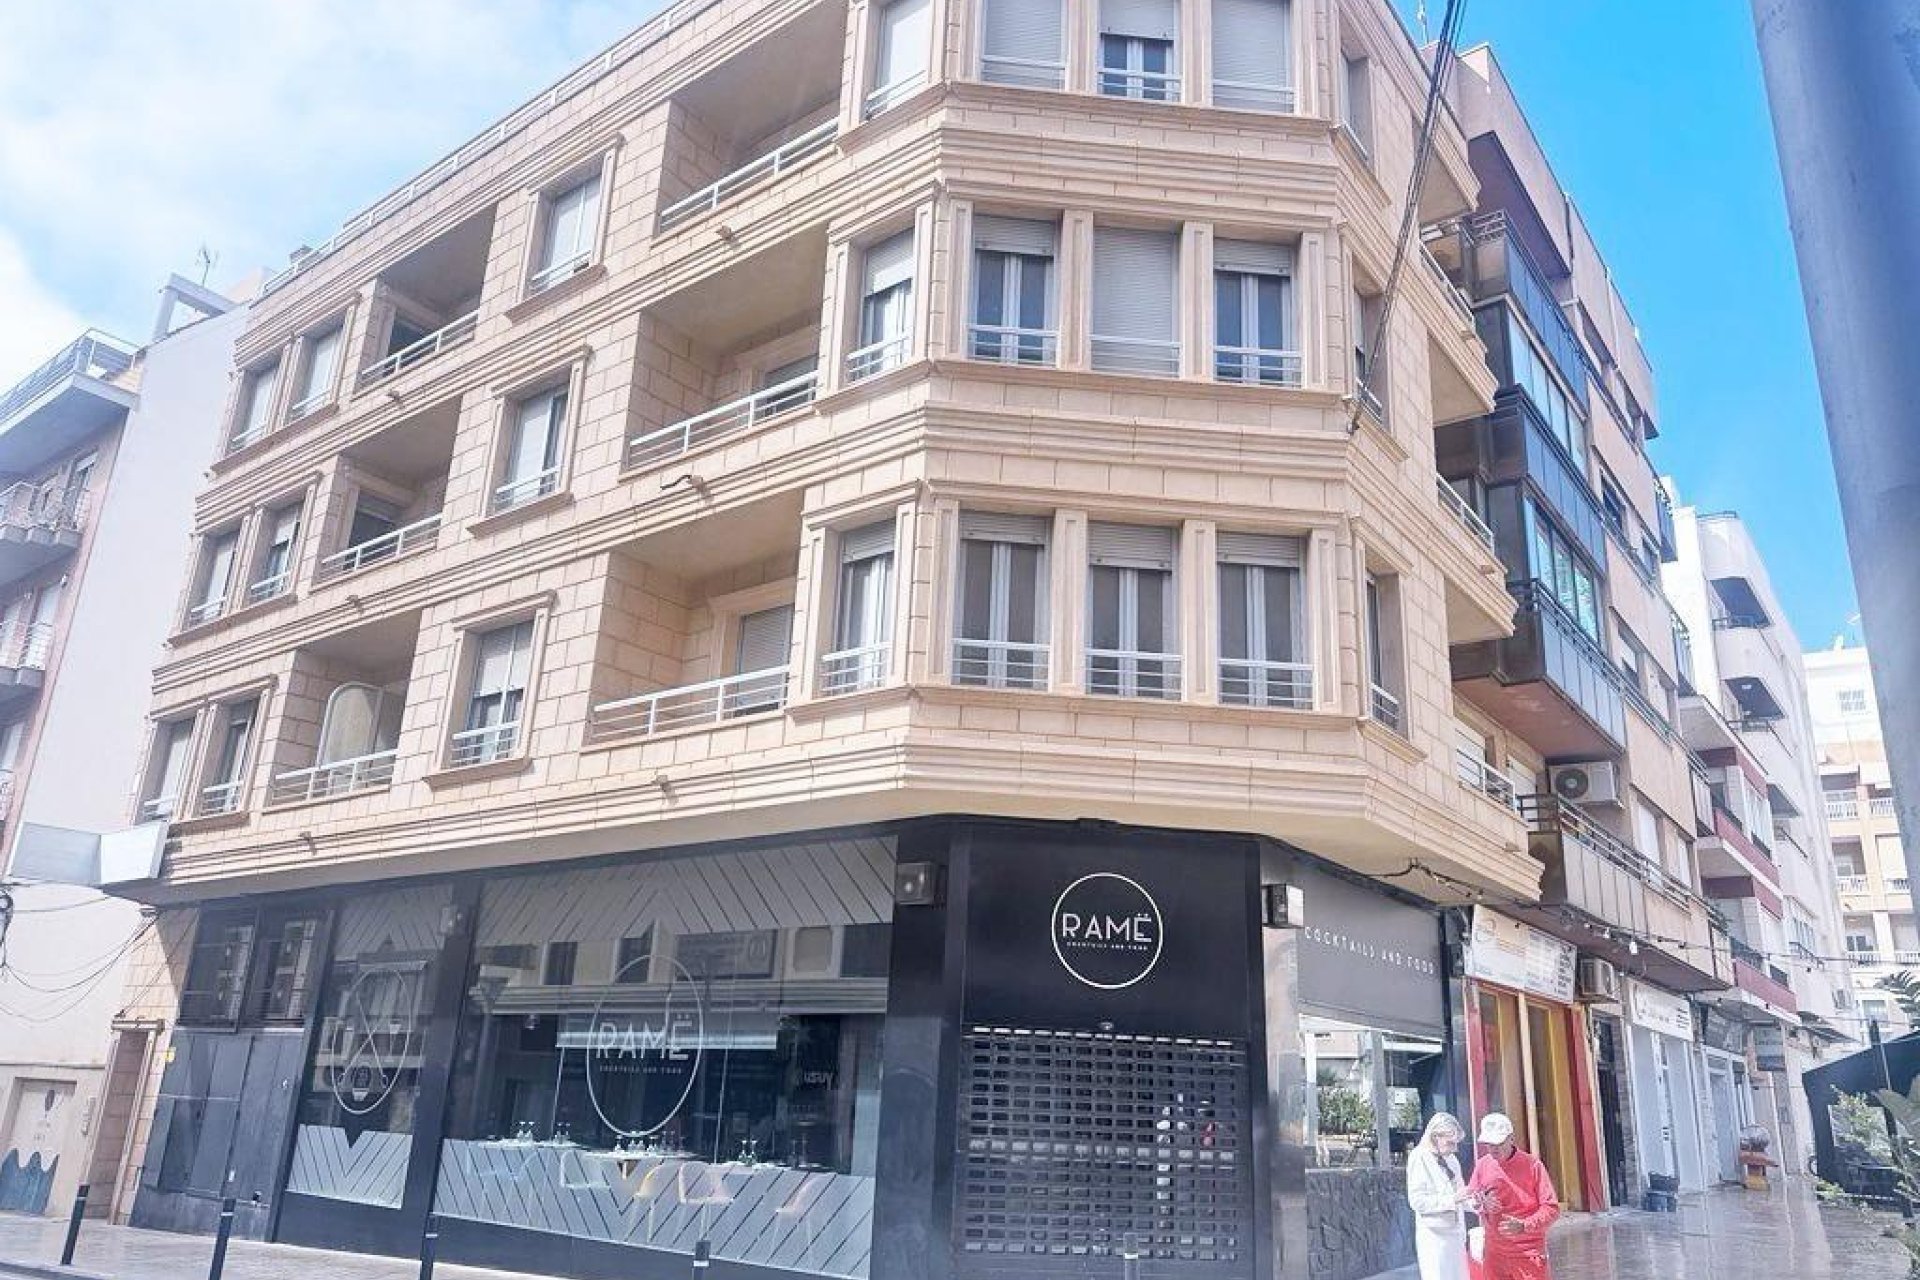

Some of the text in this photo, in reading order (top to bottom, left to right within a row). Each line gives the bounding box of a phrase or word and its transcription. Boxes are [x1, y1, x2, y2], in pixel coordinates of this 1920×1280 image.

[1062, 913, 1152, 943] RAMË
[1304, 926, 1434, 975] COCKTAILS AND FOOD
[595, 1014, 693, 1061] RAMË
